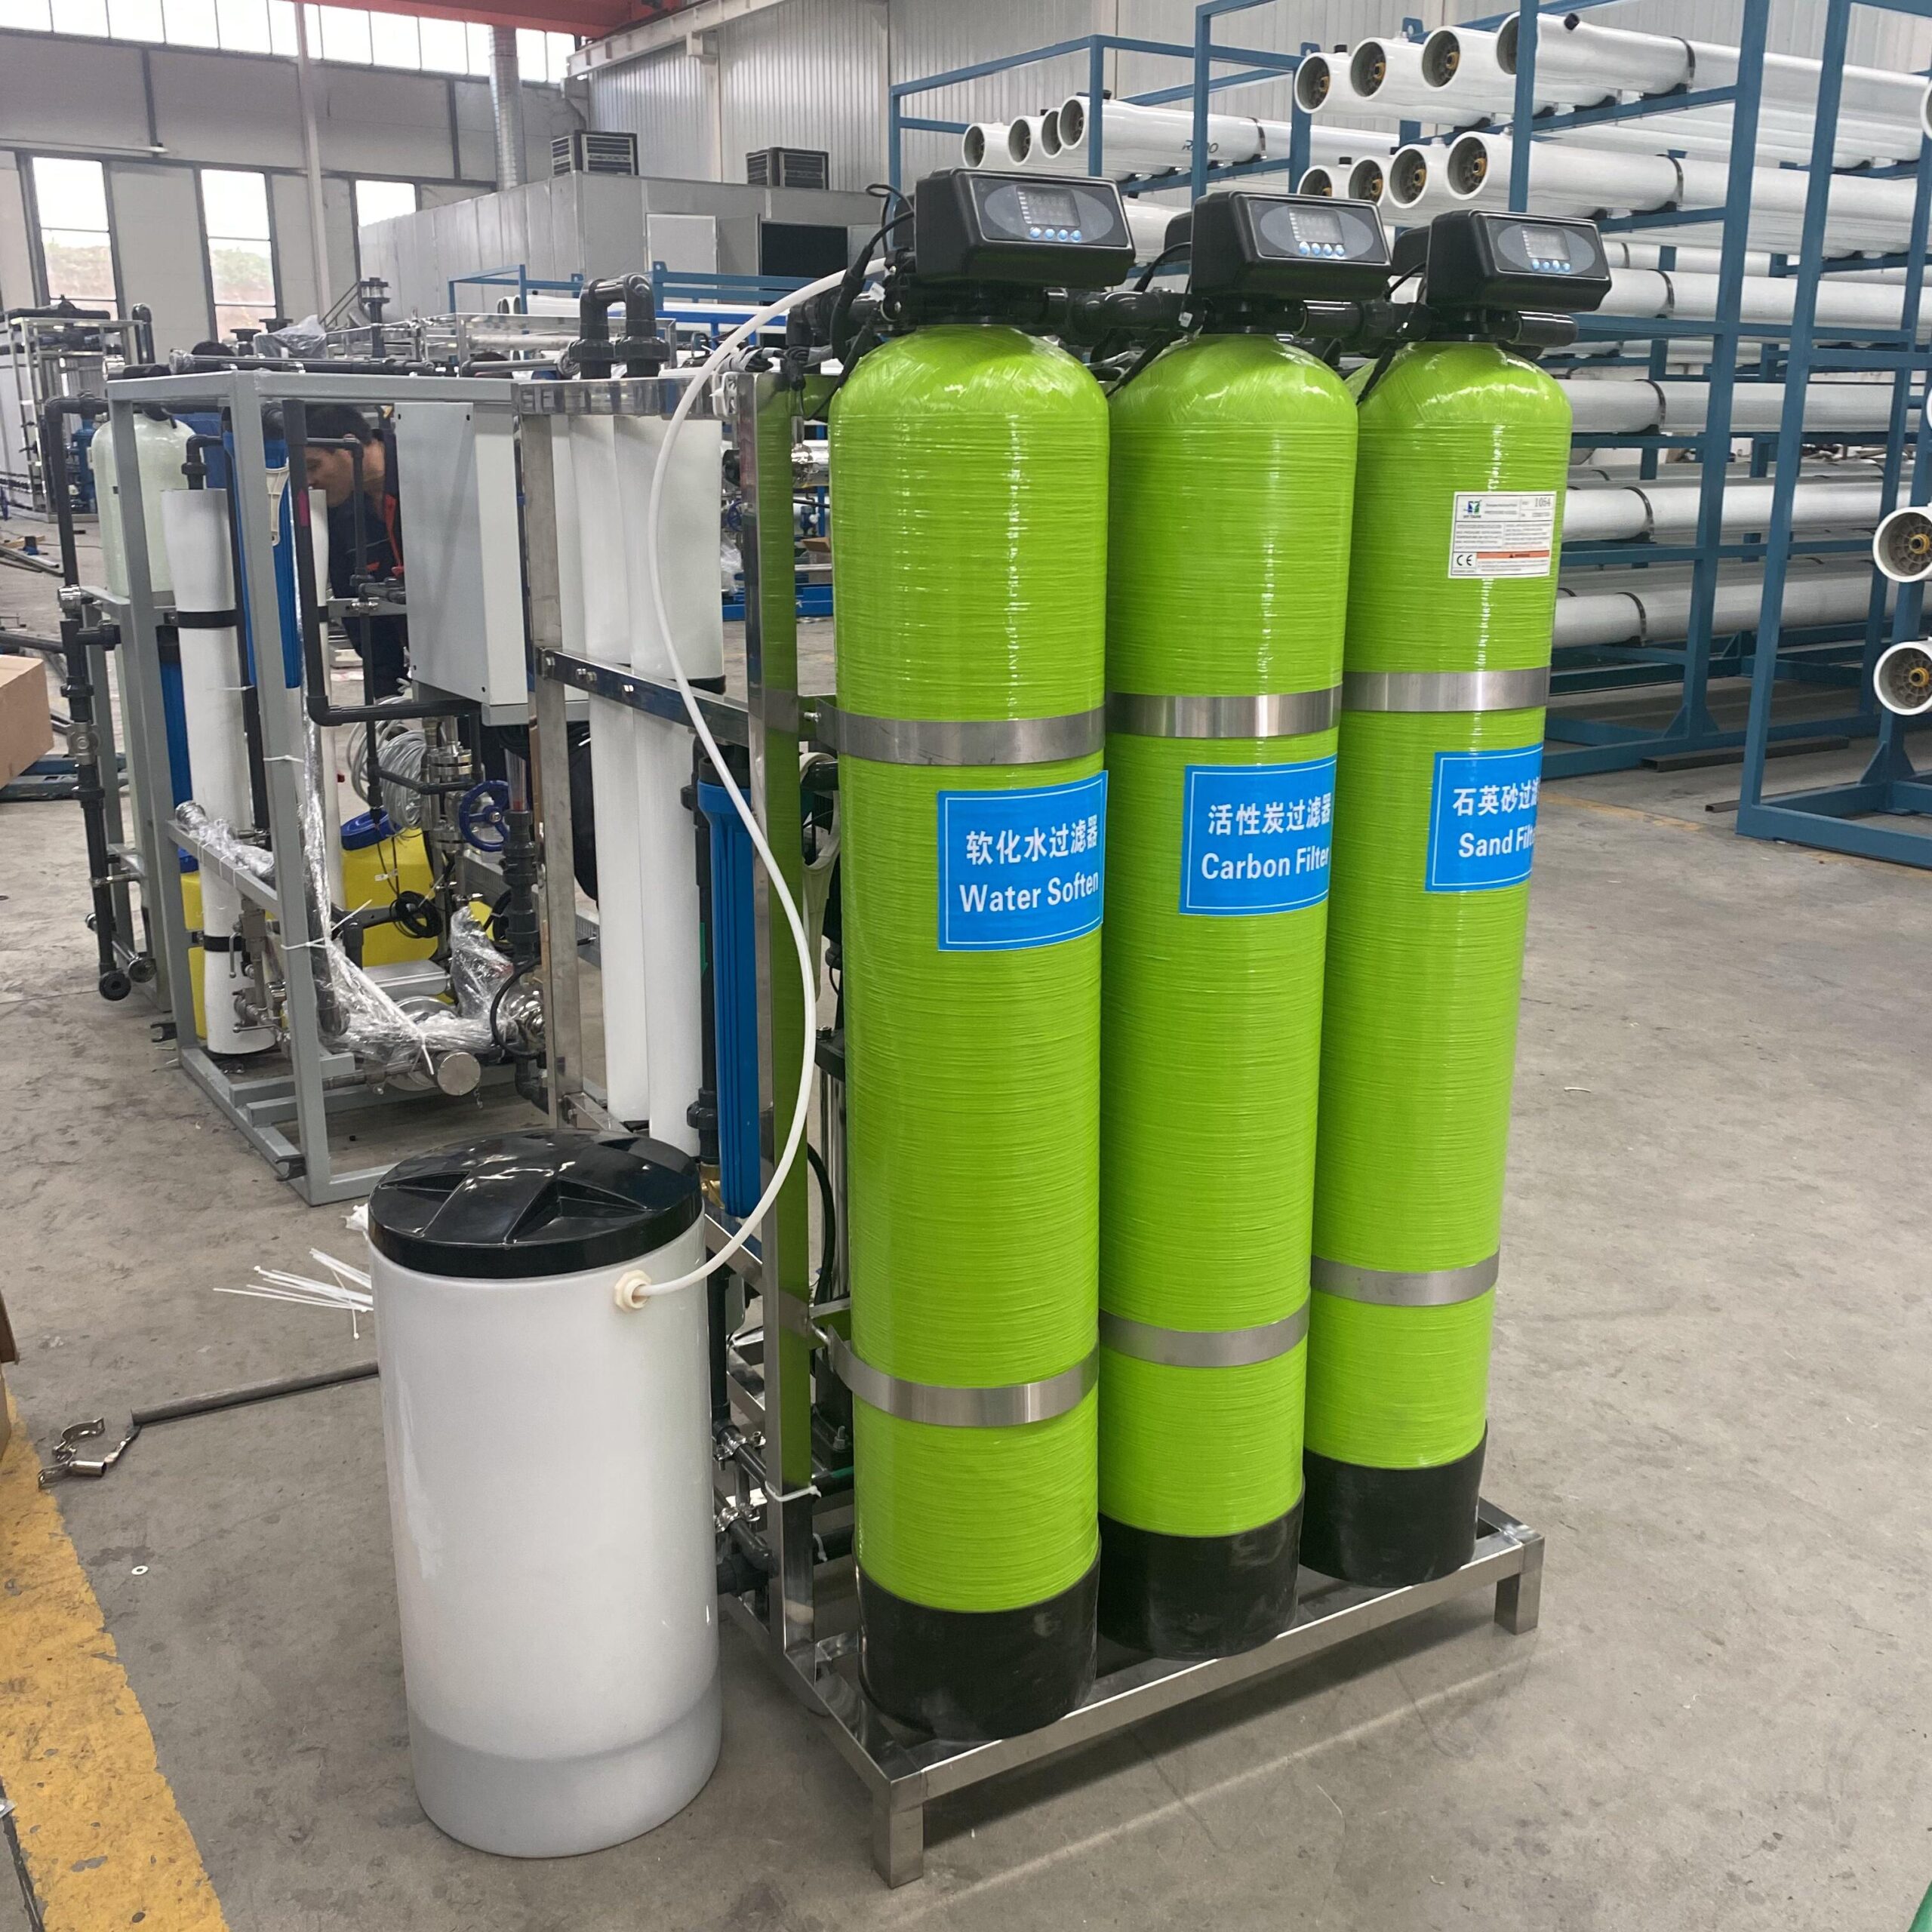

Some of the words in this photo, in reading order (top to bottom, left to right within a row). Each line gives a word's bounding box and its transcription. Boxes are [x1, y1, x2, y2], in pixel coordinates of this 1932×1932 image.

[966, 814, 1097, 866] 软化水过滤器
[1458, 829, 1513, 858] Sand
[1201, 852, 1291, 880] Carbon
[1295, 844, 1329, 875] Filter
[959, 884, 1041, 912] Water
[1047, 872, 1099, 906] Soften
